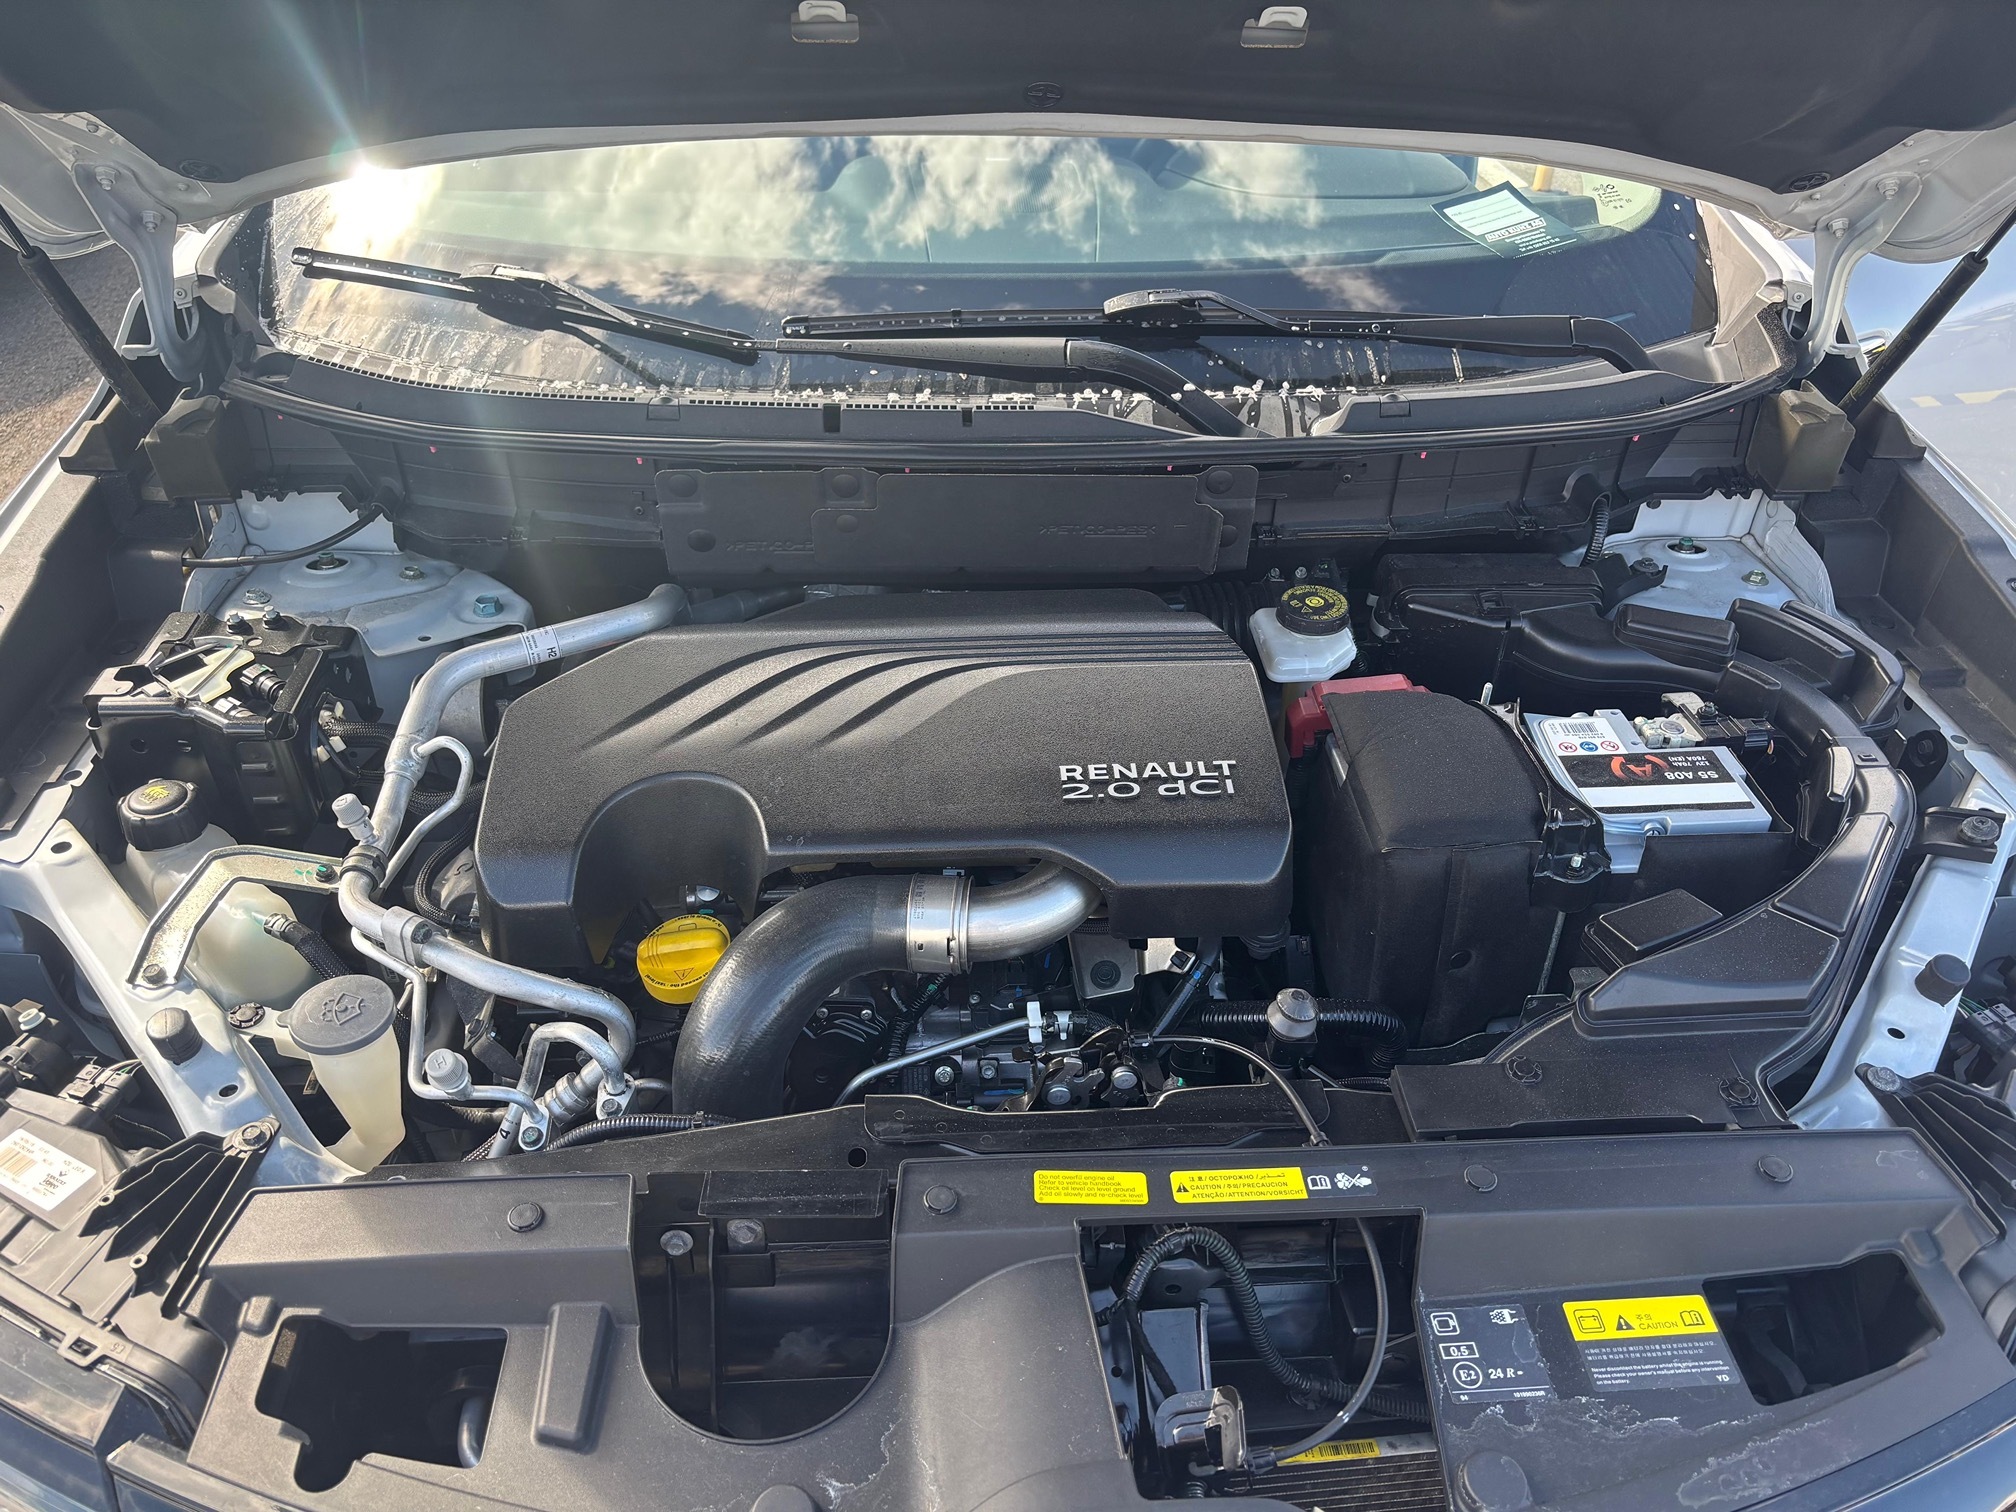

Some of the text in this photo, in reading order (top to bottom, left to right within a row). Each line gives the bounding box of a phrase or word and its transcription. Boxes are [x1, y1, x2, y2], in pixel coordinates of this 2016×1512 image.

[547, 646, 557, 659] H2
[1058, 760, 1237, 781] RENAULT
[1062, 781, 1141, 799] 2.0
[1635, 1313, 1653, 1322] 주의
[1638, 1321, 1679, 1331] CAUTION
[1459, 1369, 1477, 1381] E2
[1488, 1367, 1505, 1379] 24
[1506, 1367, 1516, 1378] R
[1715, 1374, 1730, 1382] YD
